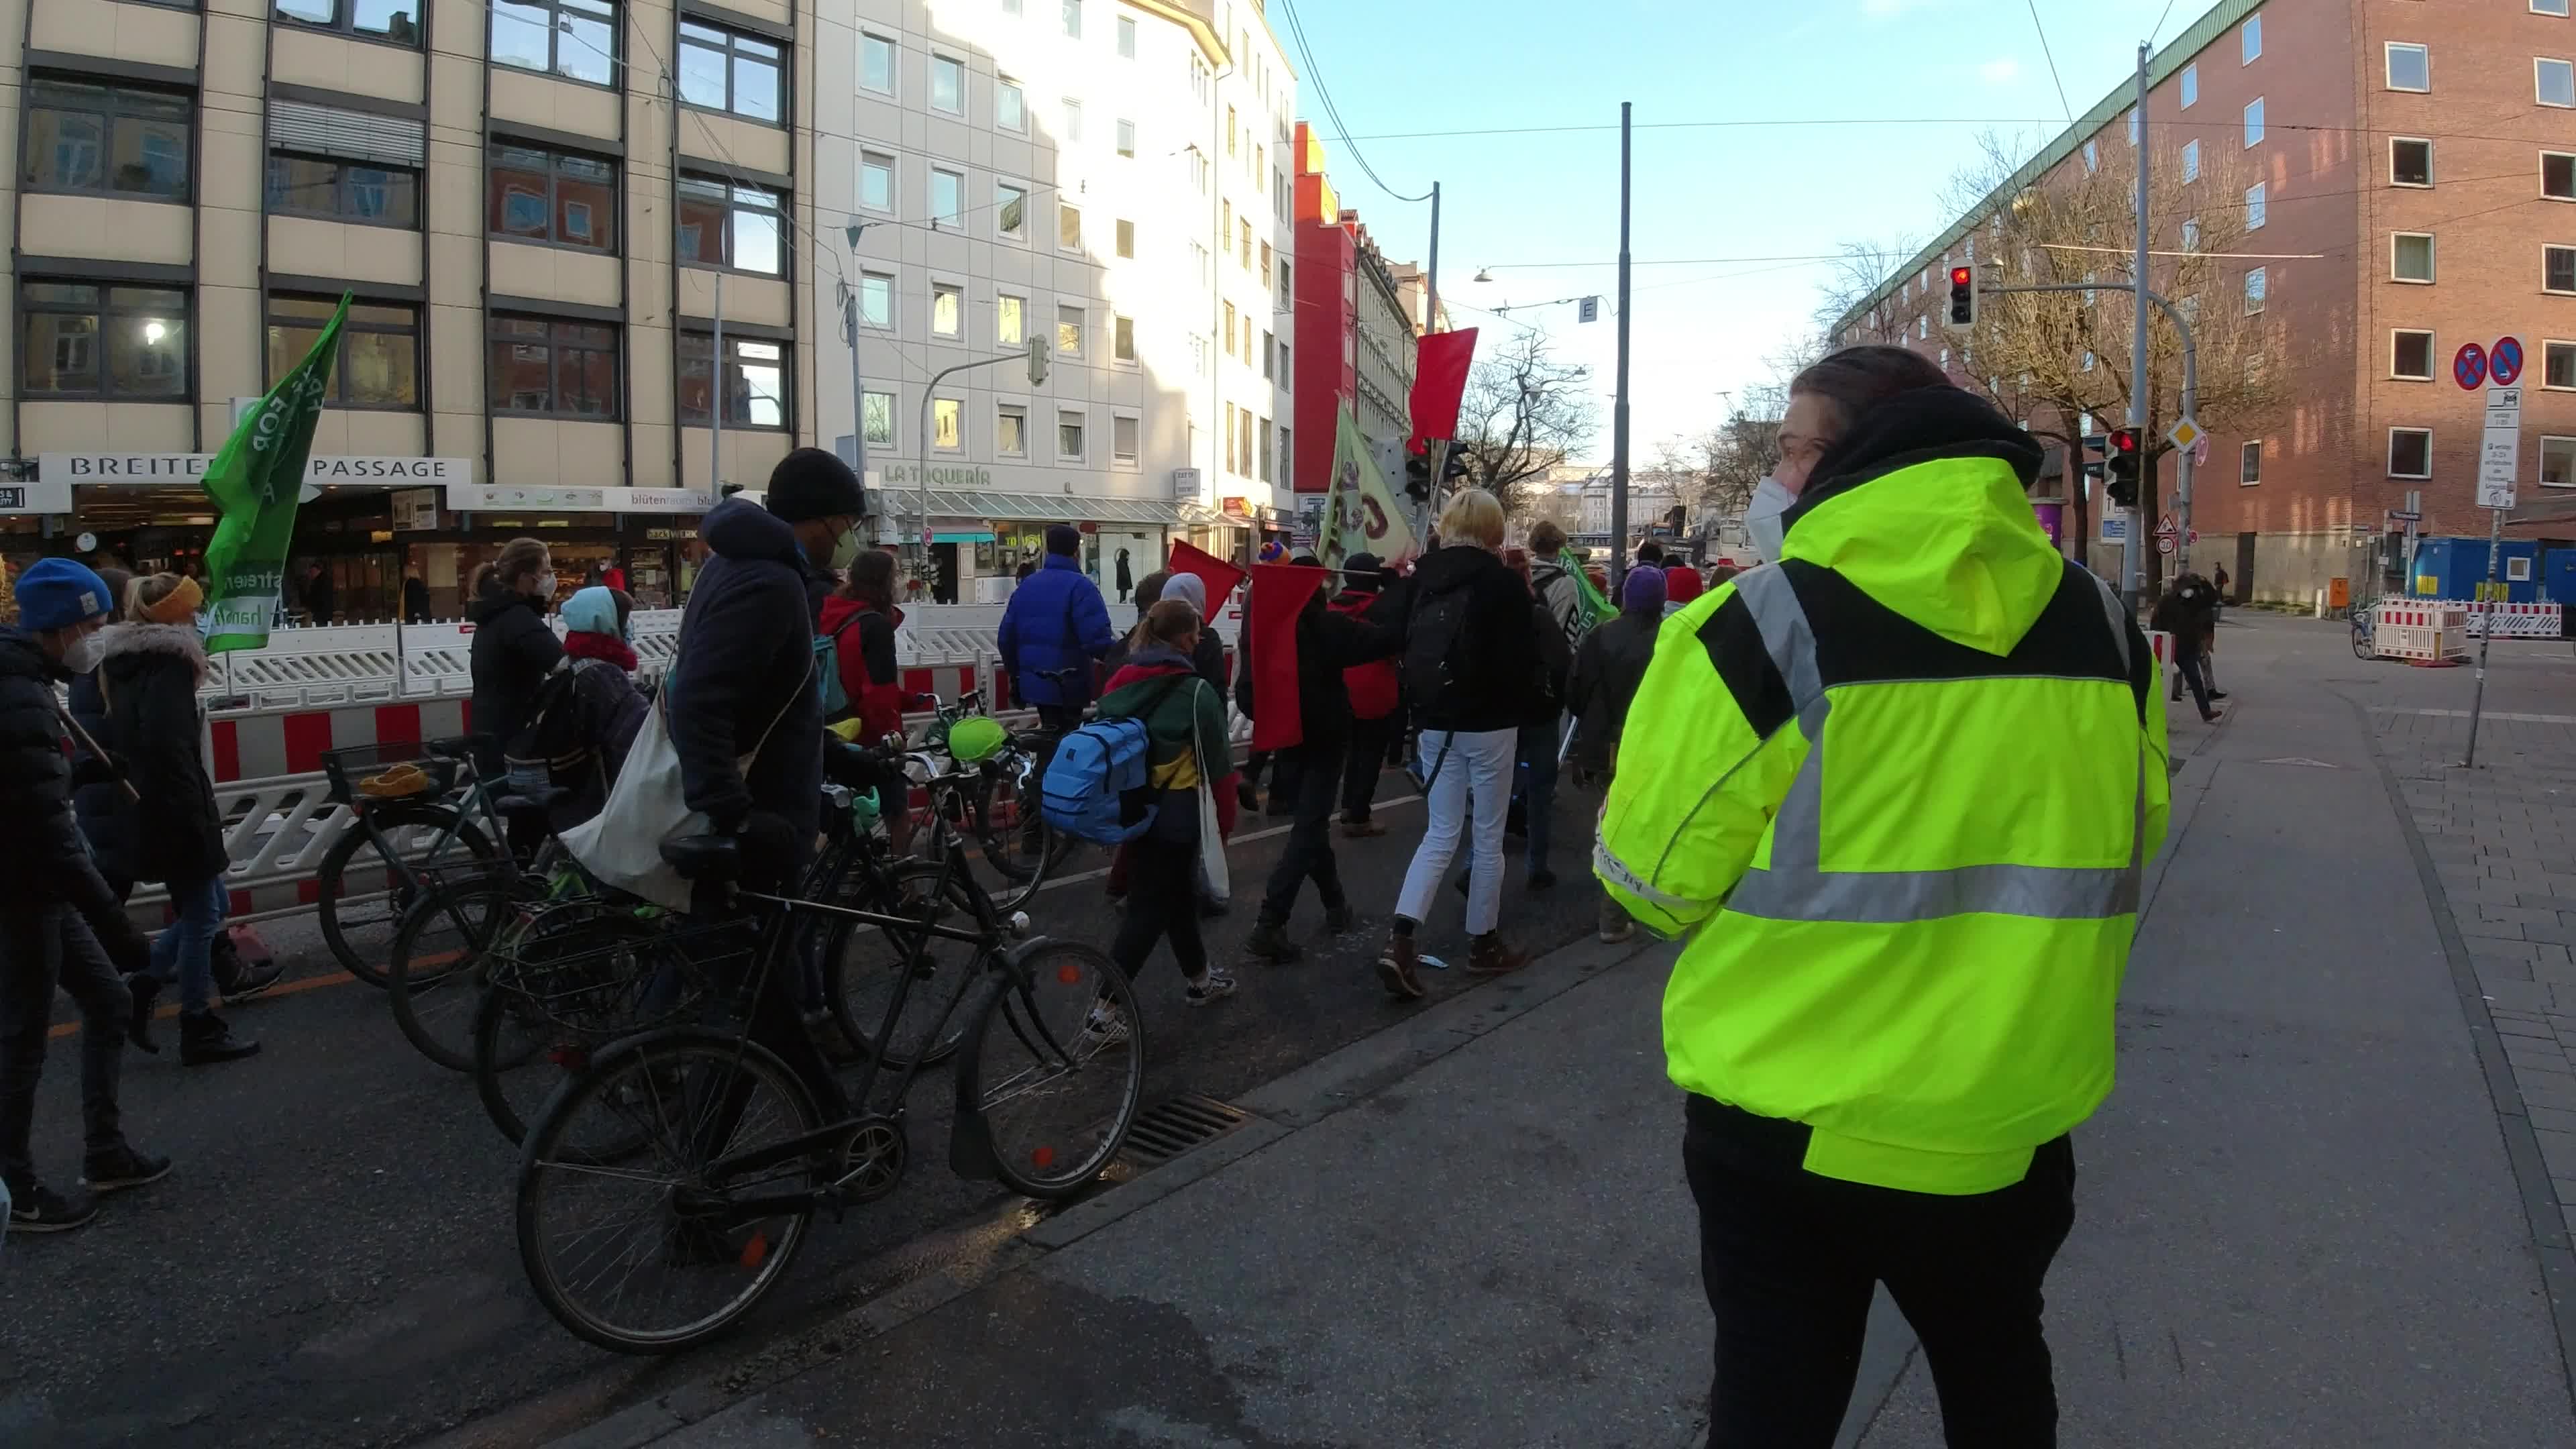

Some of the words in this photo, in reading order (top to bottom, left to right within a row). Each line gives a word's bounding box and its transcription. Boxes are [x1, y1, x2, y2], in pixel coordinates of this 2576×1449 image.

[1583, 303, 1593, 317] E
[70, 458, 217, 475] BREITE
[313, 460, 446, 477] PASSAGE
[885, 465, 905, 482] LA
[2161, 541, 2171, 549] 30
